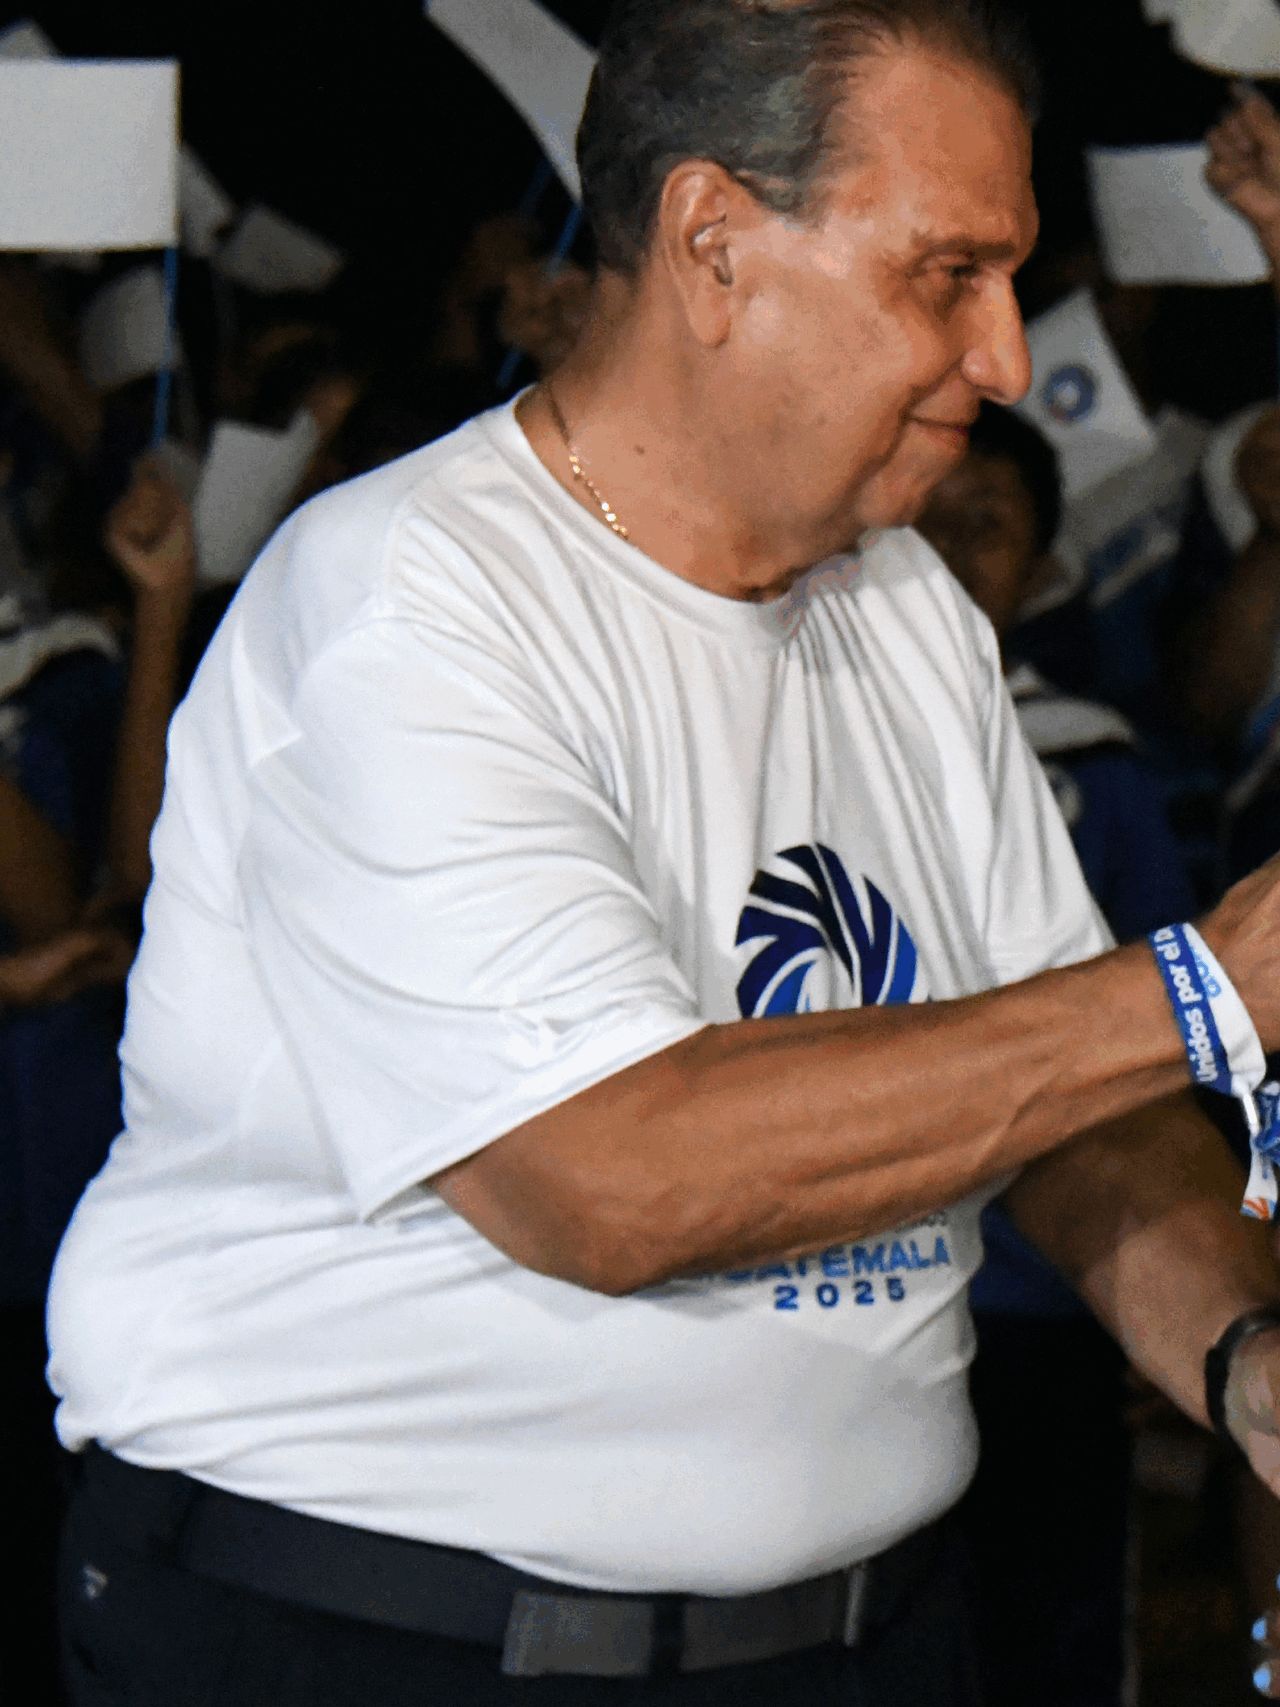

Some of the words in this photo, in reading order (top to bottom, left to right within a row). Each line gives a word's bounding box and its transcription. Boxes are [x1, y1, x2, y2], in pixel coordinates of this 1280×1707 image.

[1156, 941, 1181, 961] el
[1169, 964, 1203, 1004] por
[1185, 1008, 1219, 1082] Unidos
[773, 1276, 905, 1311] 2025
